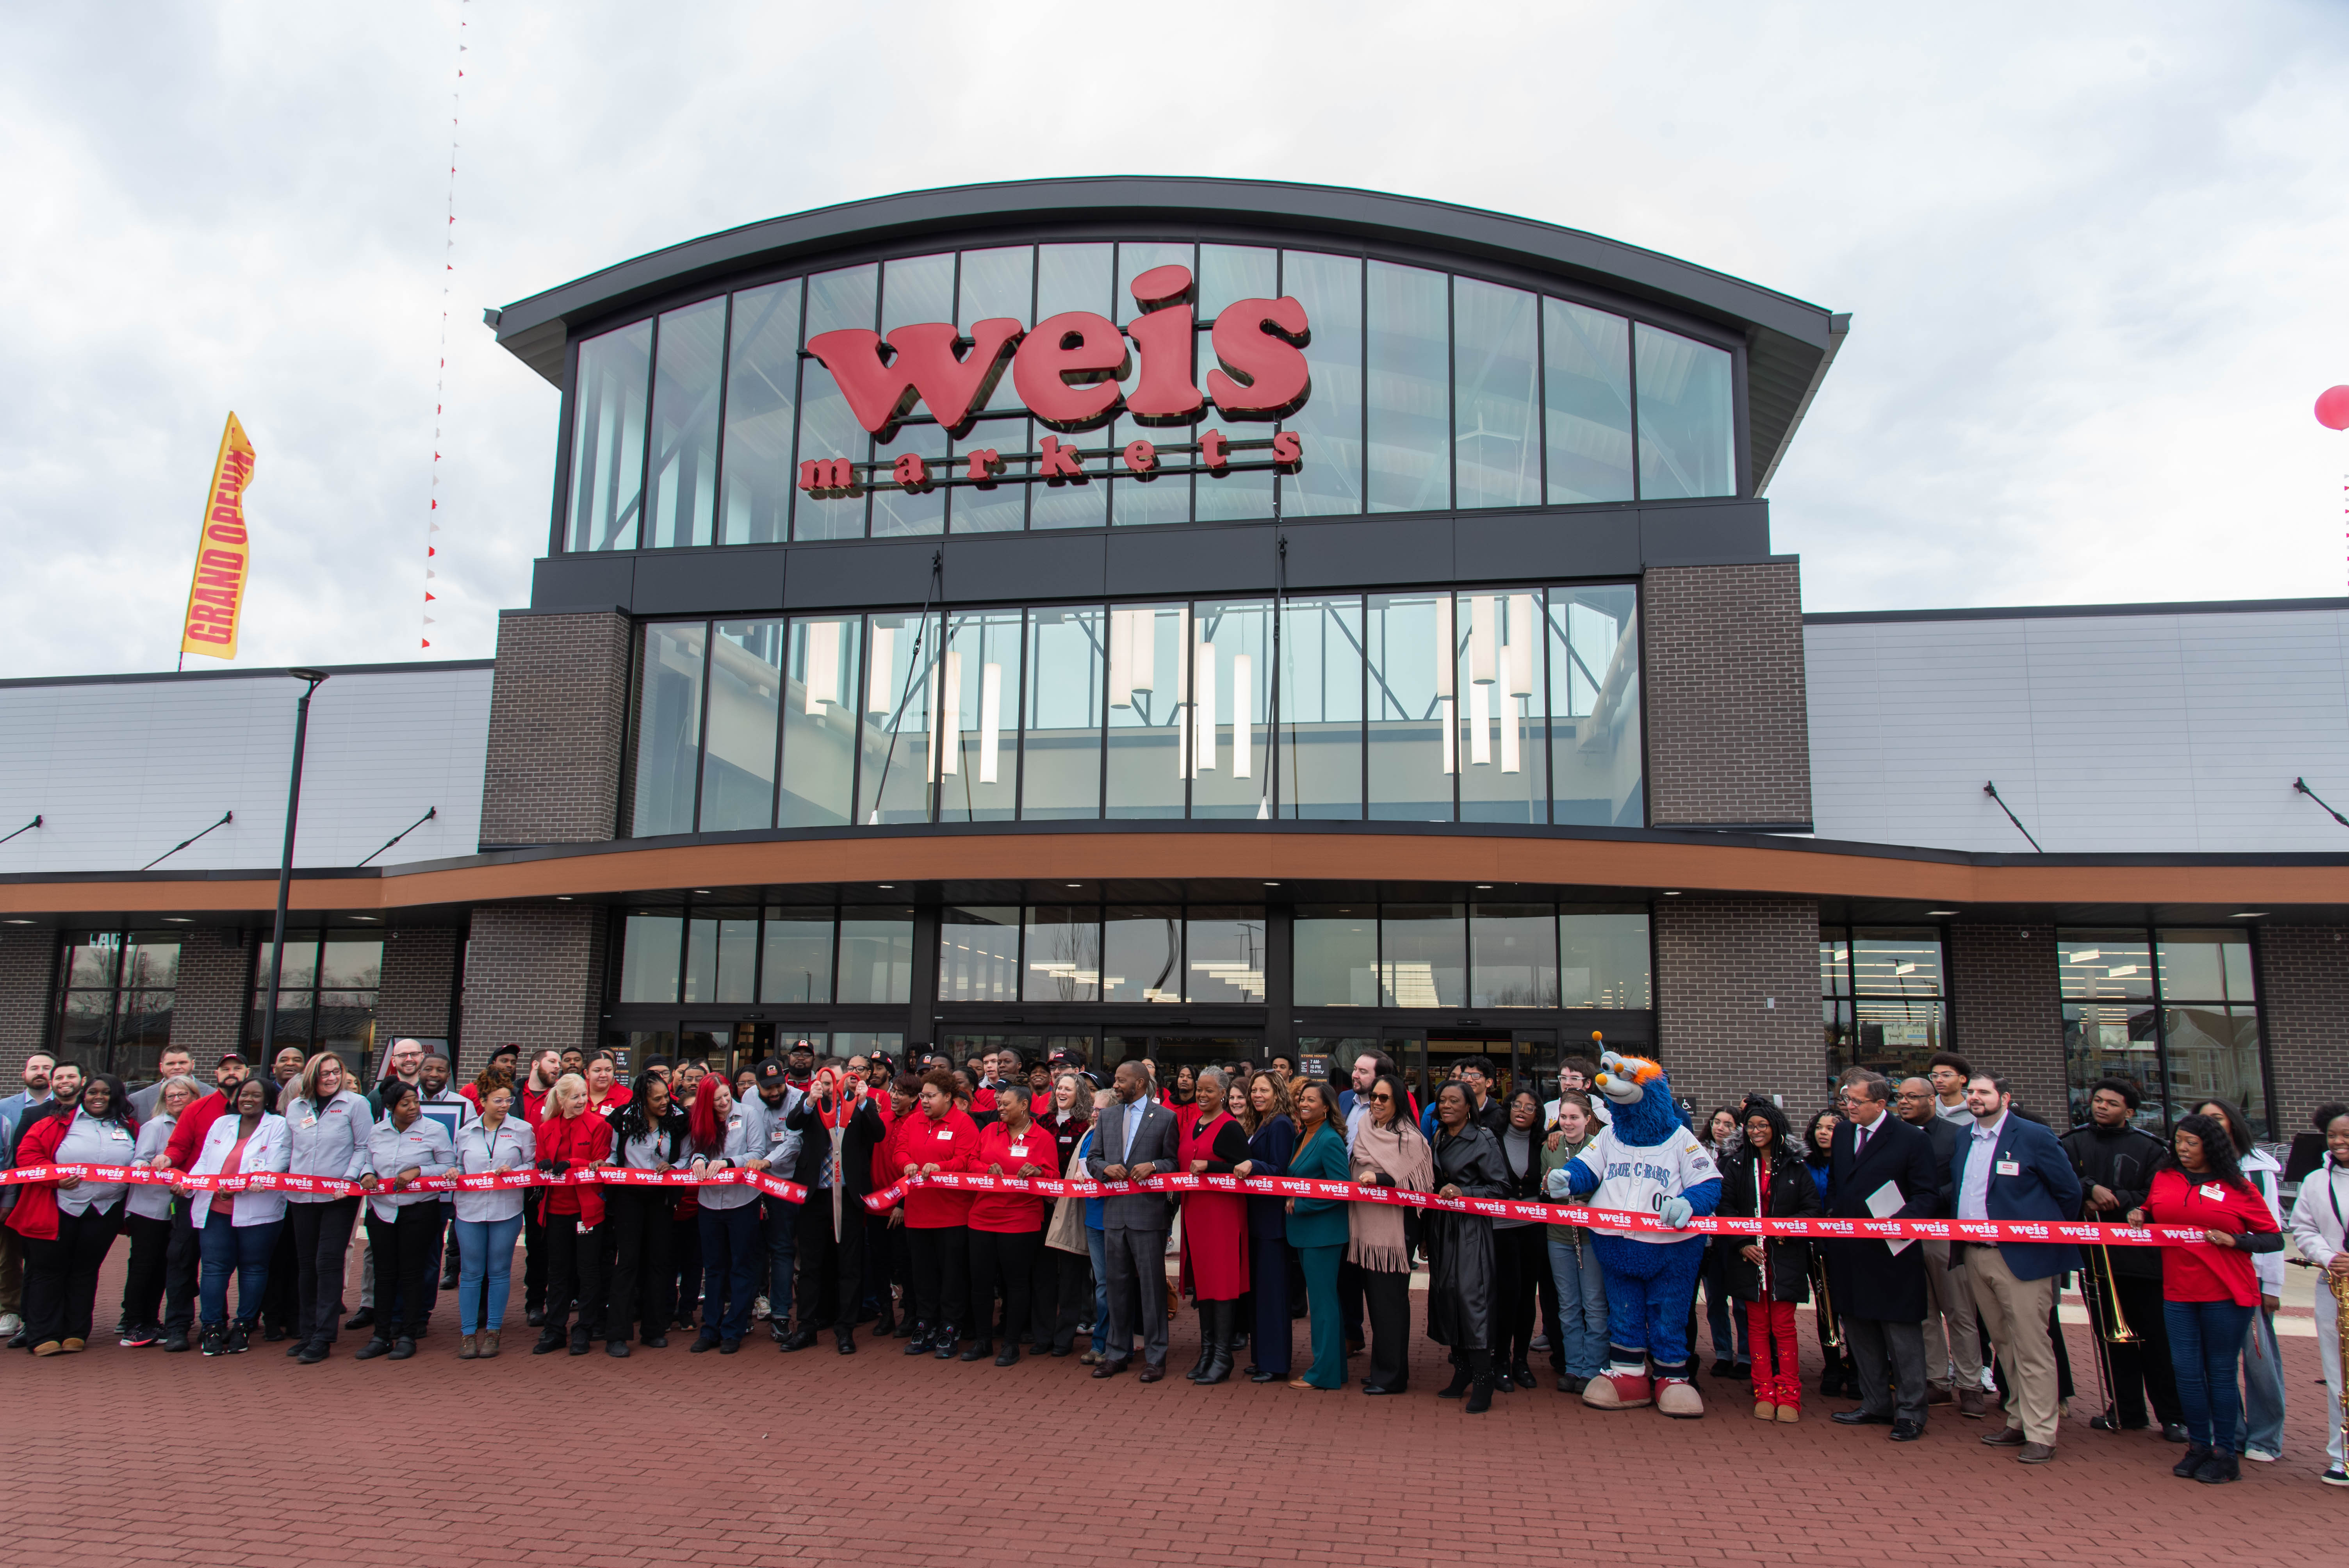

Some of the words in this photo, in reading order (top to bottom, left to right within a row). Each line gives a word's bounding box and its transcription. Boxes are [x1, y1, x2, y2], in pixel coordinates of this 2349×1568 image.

[807, 265, 1309, 435] weis
[799, 429, 1303, 493] markets
[187, 548, 244, 645] GRAND
[16, 1167, 47, 1178] weis
[55, 1165, 87, 1175] weis
[96, 1168, 125, 1178] weis
[154, 1170, 174, 1180] weis
[600, 1170, 627, 1179] weis
[1605, 1162, 1631, 1180] BLUE
[1633, 1162, 1670, 1188] CRABS
[182, 1176, 210, 1185] weis
[218, 1176, 246, 1186] weis
[463, 1176, 494, 1186] weis
[502, 1173, 531, 1184] weis
[635, 1172, 663, 1181] weis
[931, 1174, 959, 1183] weis
[966, 1176, 994, 1185] weis
[1138, 1176, 1163, 1186] weis
[1171, 1174, 1199, 1184] weis
[1207, 1176, 1235, 1186] weis
[284, 1178, 312, 1187] weis
[321, 1181, 350, 1189] weis
[1002, 1178, 1028, 1187] weis
[1036, 1181, 1064, 1191] weis
[1072, 1181, 1097, 1191] weis
[1104, 1180, 1128, 1190] weis
[1244, 1178, 1273, 1188] weis
[1281, 1180, 1310, 1191] weis
[1319, 1183, 1349, 1194] weis
[1358, 1187, 1388, 1197] weis
[1396, 1192, 1426, 1202] weis
[1435, 1199, 1465, 1208] weis
[1474, 1202, 1506, 1212] weis
[1515, 1205, 1547, 1216] weis
[1556, 1209, 1589, 1220] weis
[1598, 1213, 1631, 1224] weis
[1687, 1219, 1718, 1228] weis
[1727, 1220, 1762, 1229] weis
[1772, 1220, 1807, 1229] weis
[1817, 1221, 1854, 1231] weis
[1864, 1221, 1901, 1231] weis
[1911, 1222, 1949, 1233] weis
[1959, 1222, 1998, 1234] weis
[2009, 1224, 2048, 1235] weis
[2059, 1225, 2099, 1237] weis
[2110, 1226, 2151, 1238] weis
[2162, 1228, 2204, 1240] weis
